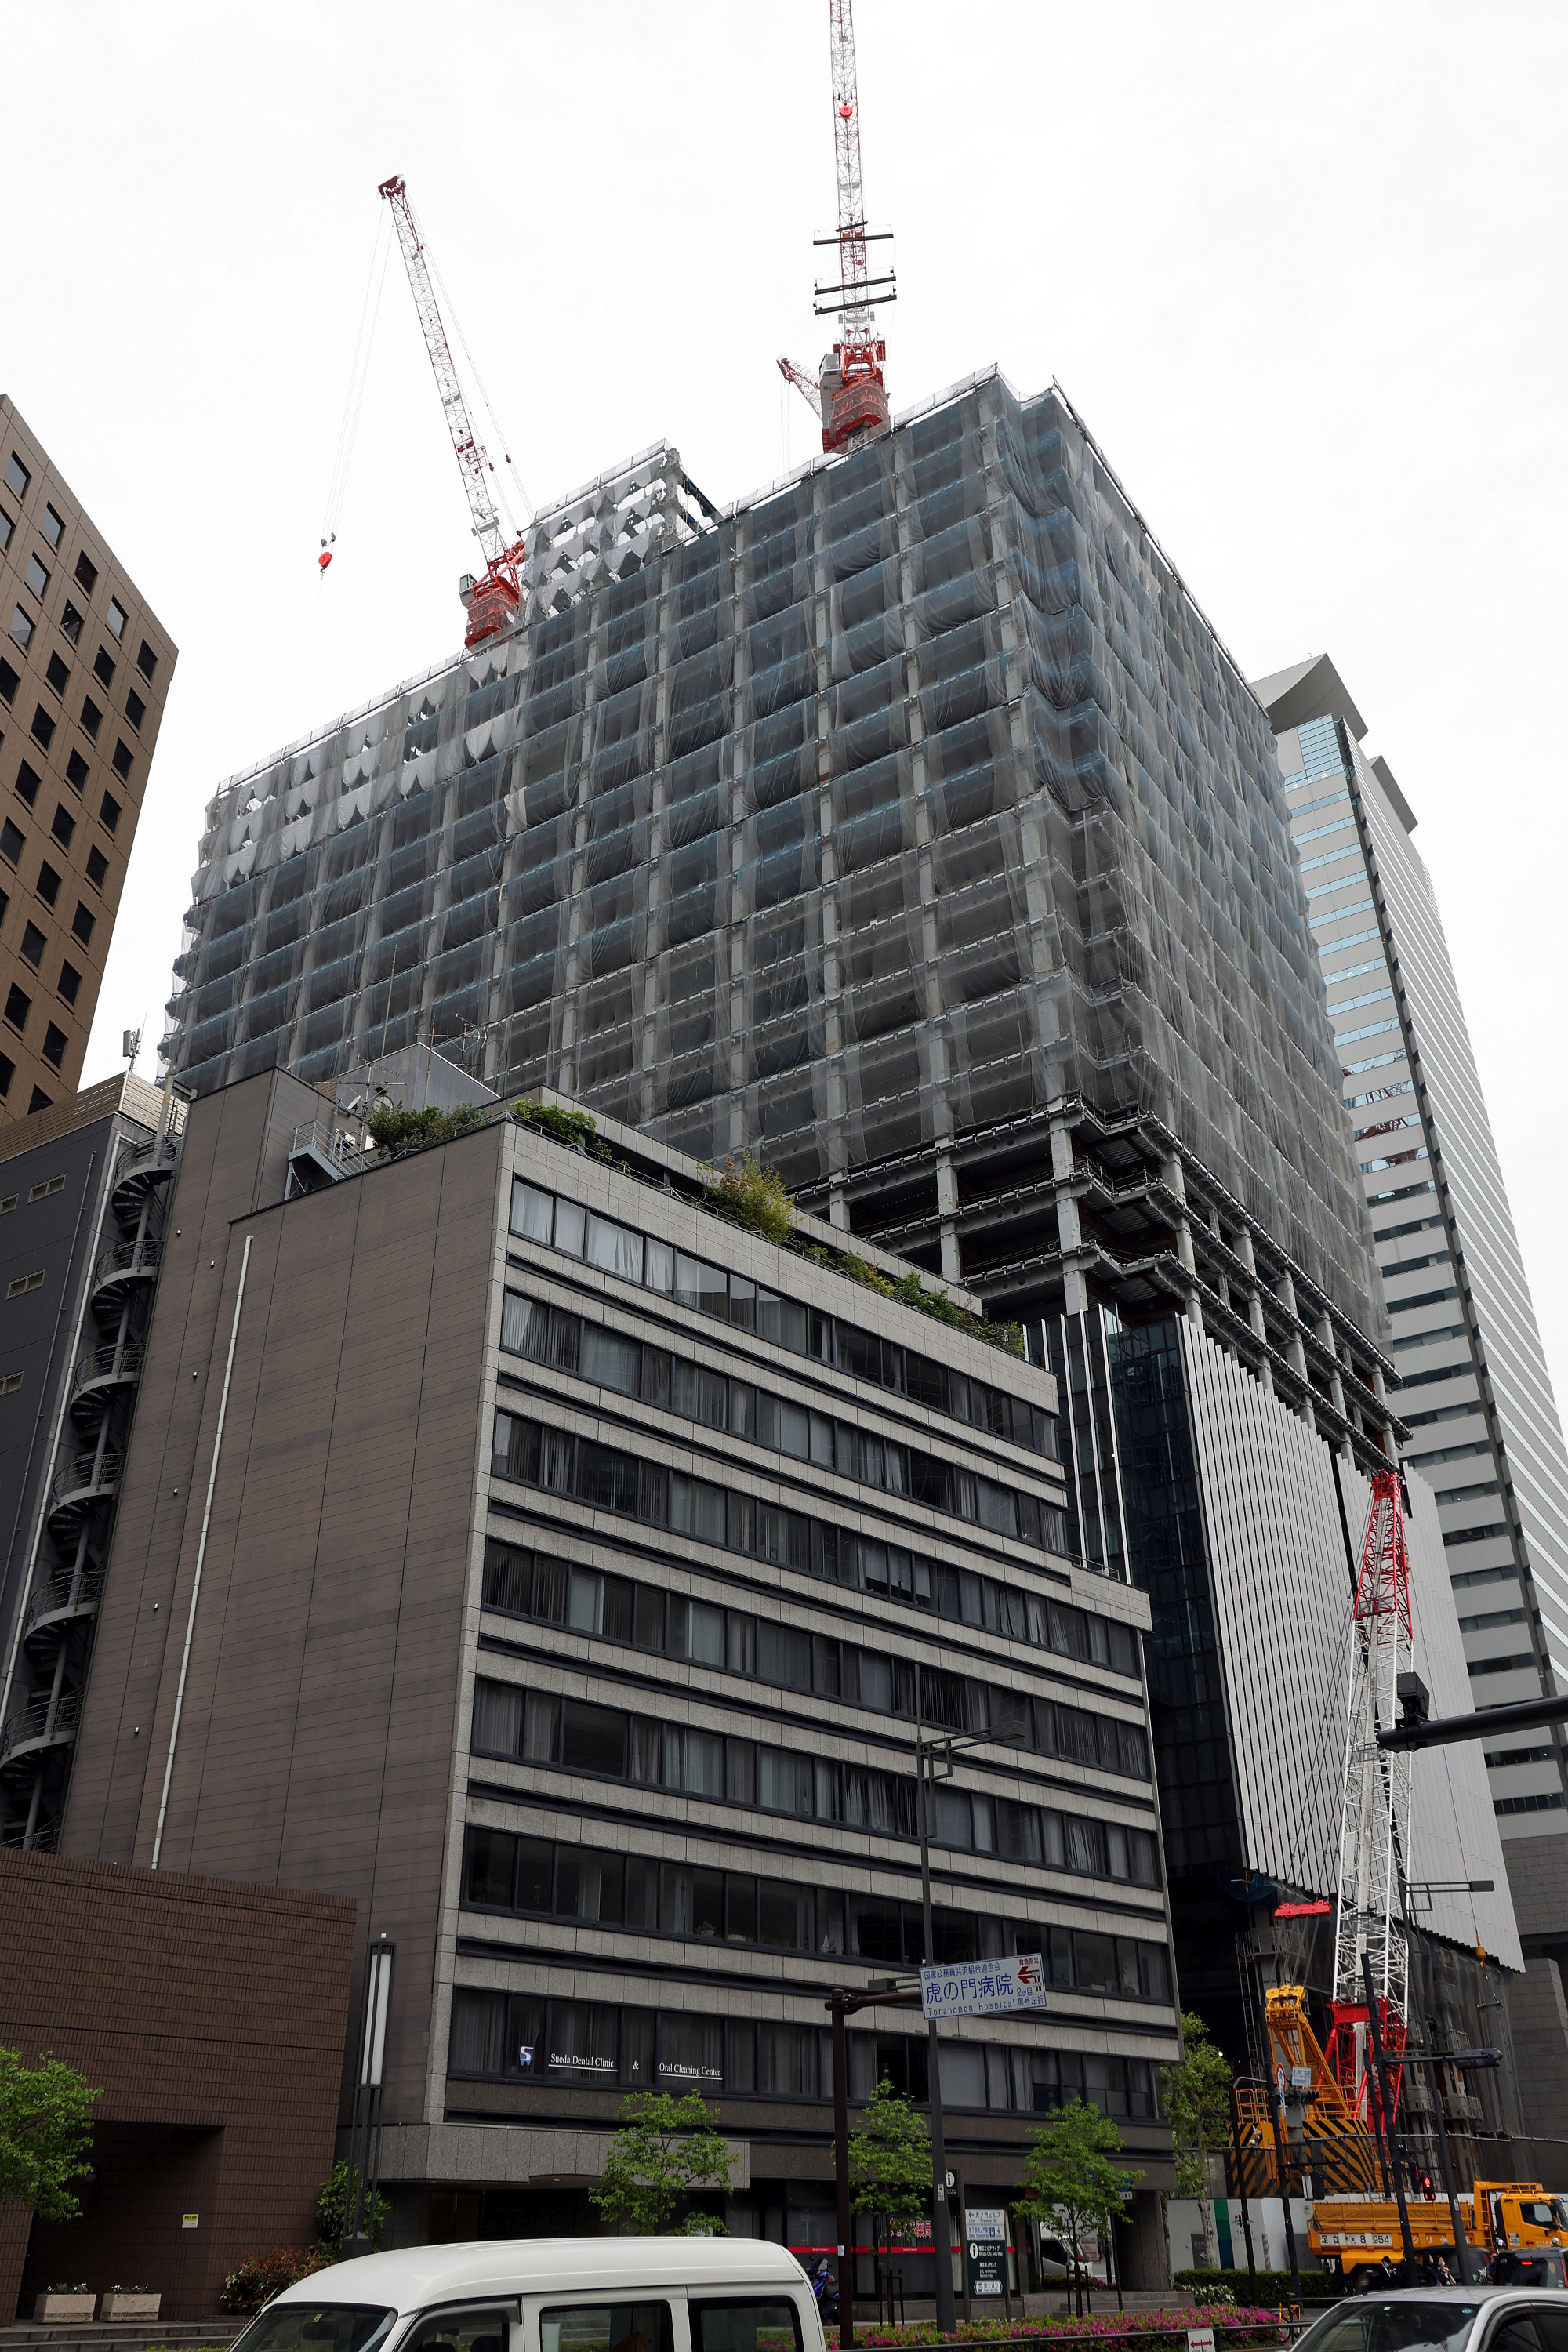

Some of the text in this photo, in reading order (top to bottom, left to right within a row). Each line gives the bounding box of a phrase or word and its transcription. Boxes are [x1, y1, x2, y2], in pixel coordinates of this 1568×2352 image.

[924, 1962, 1000, 1980] 国家公務員共済組合連合会
[927, 1973, 1014, 2004] 虎の門病院
[927, 1998, 1015, 2016] Toranomon Hospital
[1018, 1995, 1044, 2006] 信号左折
[550, 2053, 721, 2077] Sueda Dental Clinic & Oral Cleaning Center
[1321, 2235, 1339, 2244] 足立
